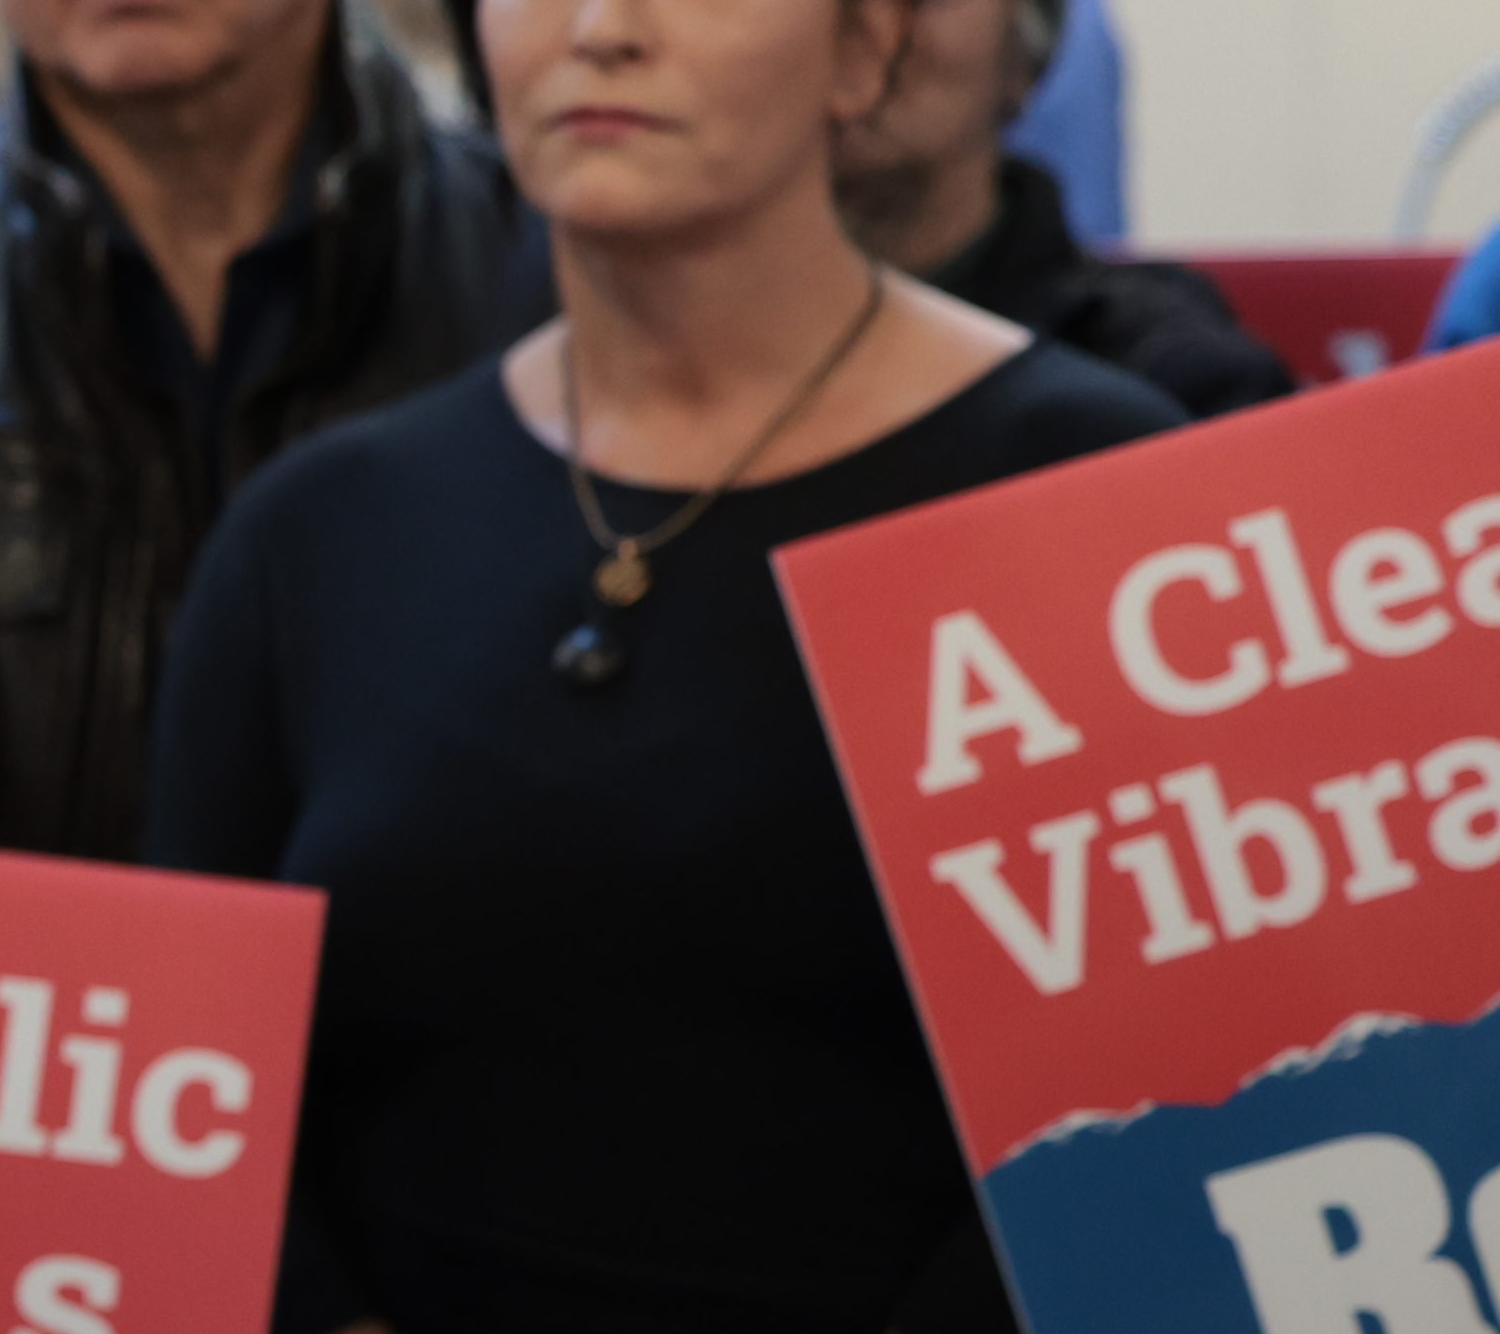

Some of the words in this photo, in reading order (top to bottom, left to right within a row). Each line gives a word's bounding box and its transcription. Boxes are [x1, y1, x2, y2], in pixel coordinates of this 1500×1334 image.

[915, 608, 1085, 798] A
[1107, 493, 1500, 717] Clea
[928, 734, 1500, 997] Vibra
